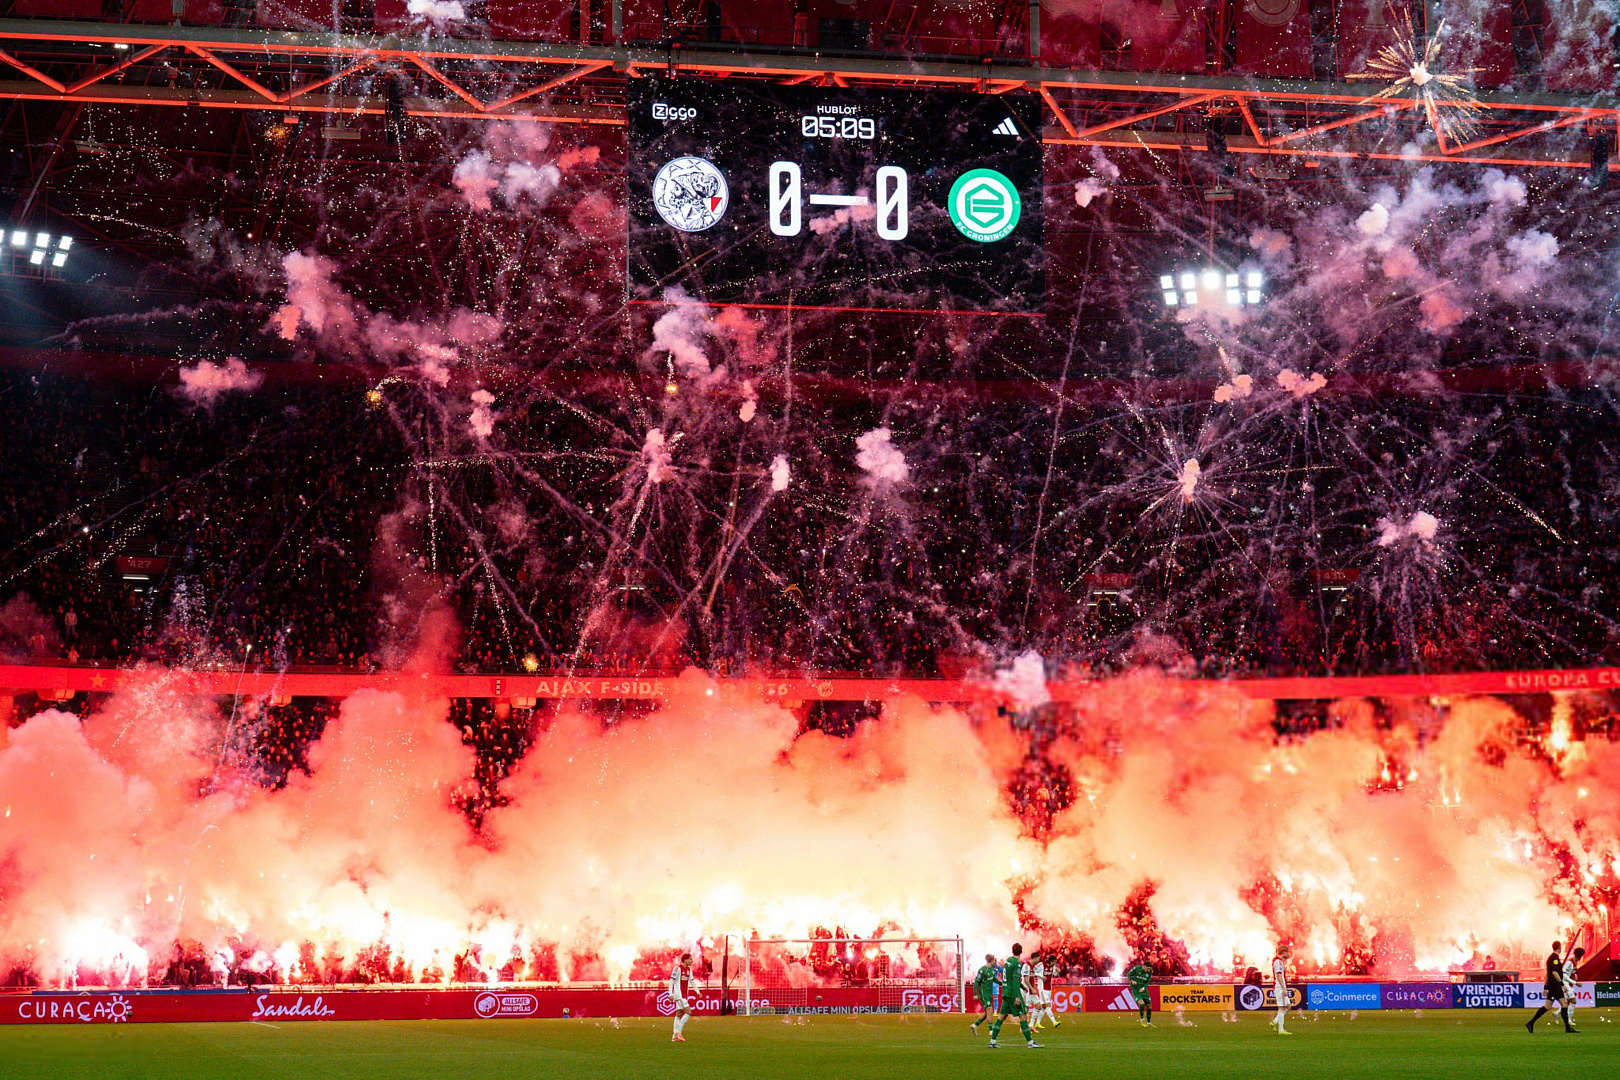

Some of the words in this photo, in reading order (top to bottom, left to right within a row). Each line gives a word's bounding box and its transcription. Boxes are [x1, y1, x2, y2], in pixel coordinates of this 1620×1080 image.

[816, 105, 858, 115] HUBLOT
[801, 115, 876, 140] 05:09
[966, 223, 1014, 242] GRONINGEN
[128, 559, 152, 569] 427
[1505, 673, 1589, 688] EUROPA
[536, 680, 593, 697] AJAX
[601, 681, 665, 696] F-SIDE
[1457, 984, 1520, 996] VRIENDEN
[1163, 995, 1221, 1004] ROCKSTARS
[1222, 995, 1232, 1003] IT
[1326, 992, 1377, 1002] Coinmerce
[1386, 991, 1446, 1003] CURAÇAO
[1465, 995, 1513, 1008] LOTERIJ
[18, 996, 131, 1022] CURAÇAO
[252, 994, 336, 1017] Sandals
[788, 1006, 829, 1015] ALLSAFE
[830, 1006, 851, 1014] MINI
[852, 1005, 888, 1015] OPSLAG
